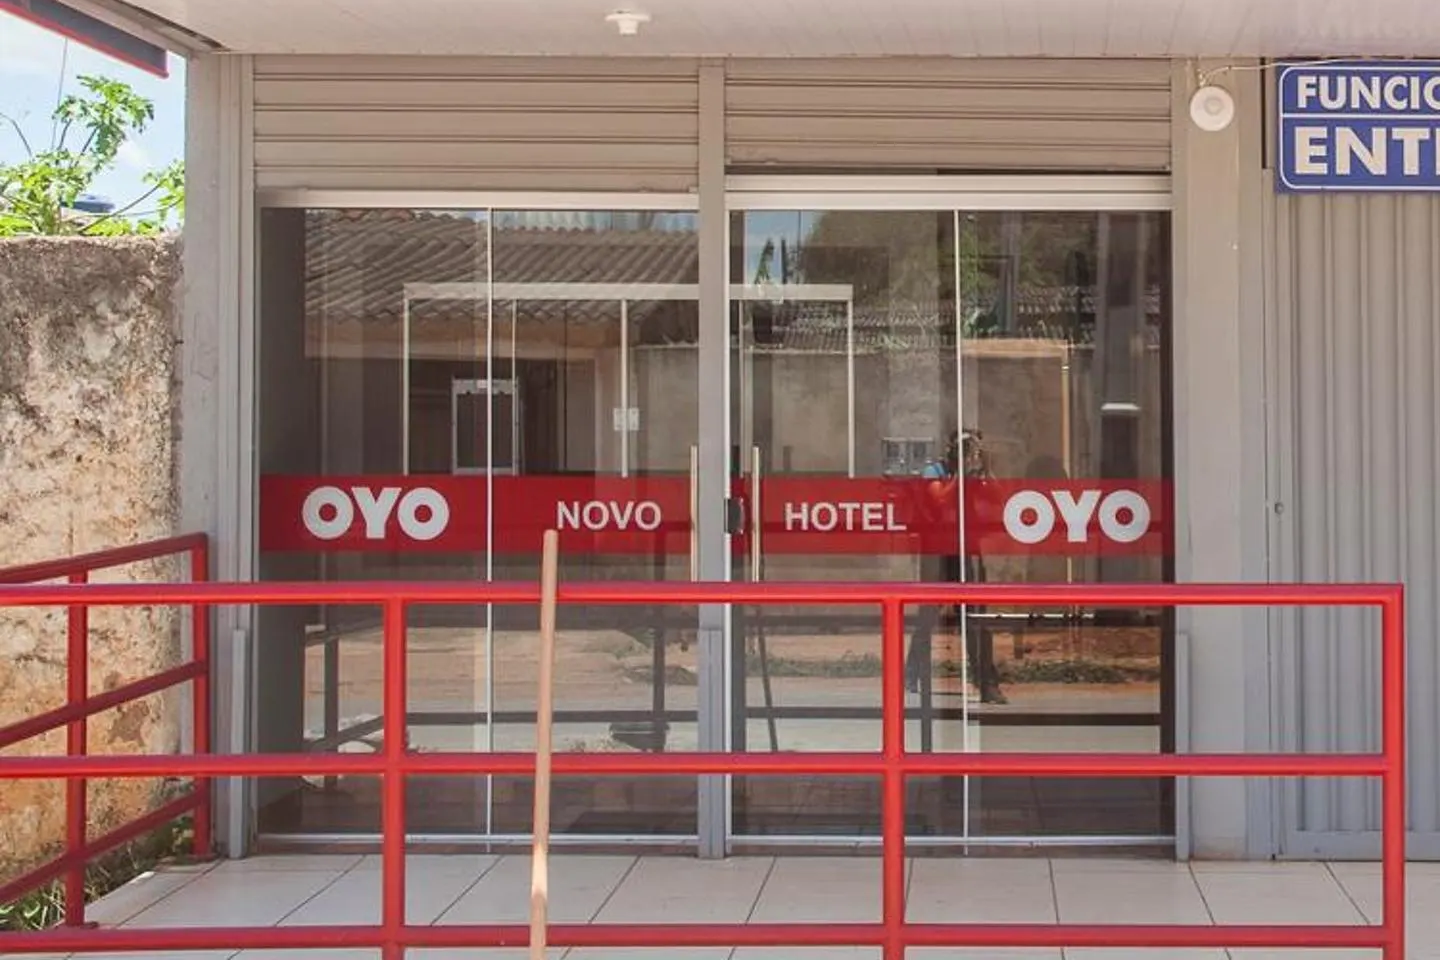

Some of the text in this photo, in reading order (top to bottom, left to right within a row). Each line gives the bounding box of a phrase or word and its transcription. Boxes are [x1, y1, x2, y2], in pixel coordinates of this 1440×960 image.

[301, 486, 1152, 544] OYO NOVO HOTEL OYO
